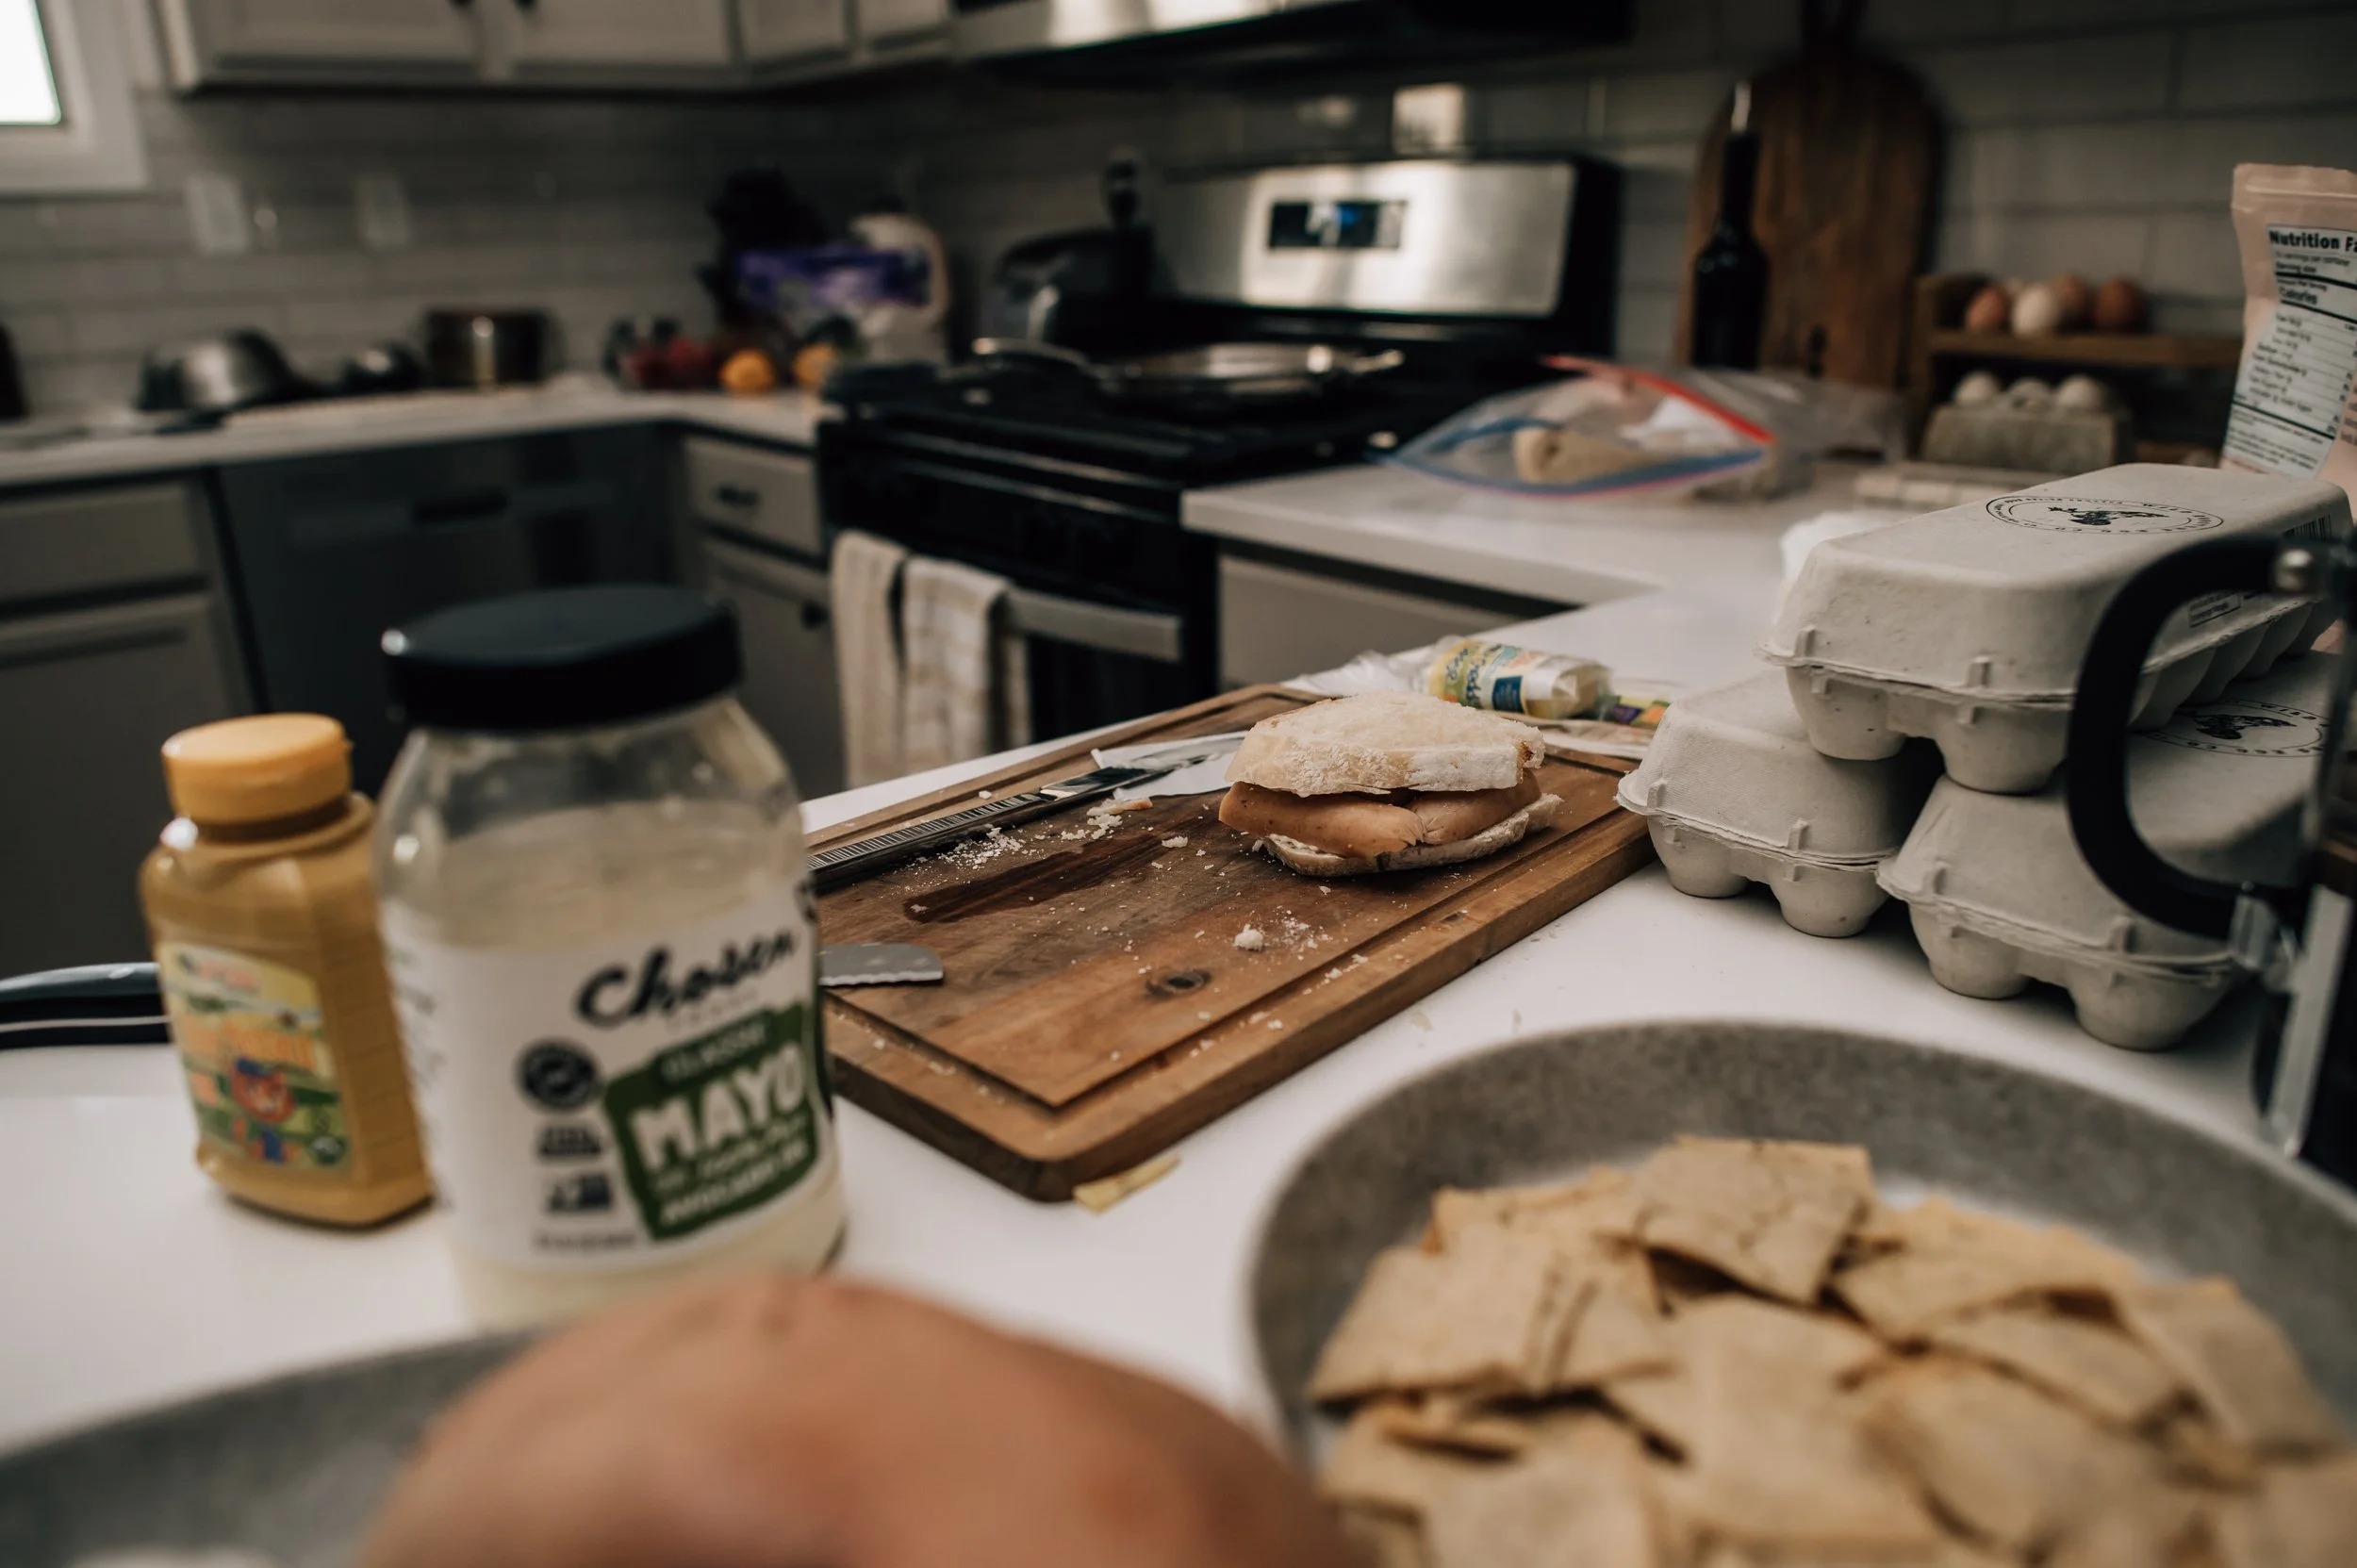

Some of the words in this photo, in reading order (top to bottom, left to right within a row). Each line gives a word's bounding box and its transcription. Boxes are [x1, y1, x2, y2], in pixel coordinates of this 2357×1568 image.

[2268, 230, 2340, 250] Nutrition
[2261, 703, 2317, 720] WILD
[578, 931, 798, 1027] Chosen
[632, 1041, 807, 1169] MAYO
